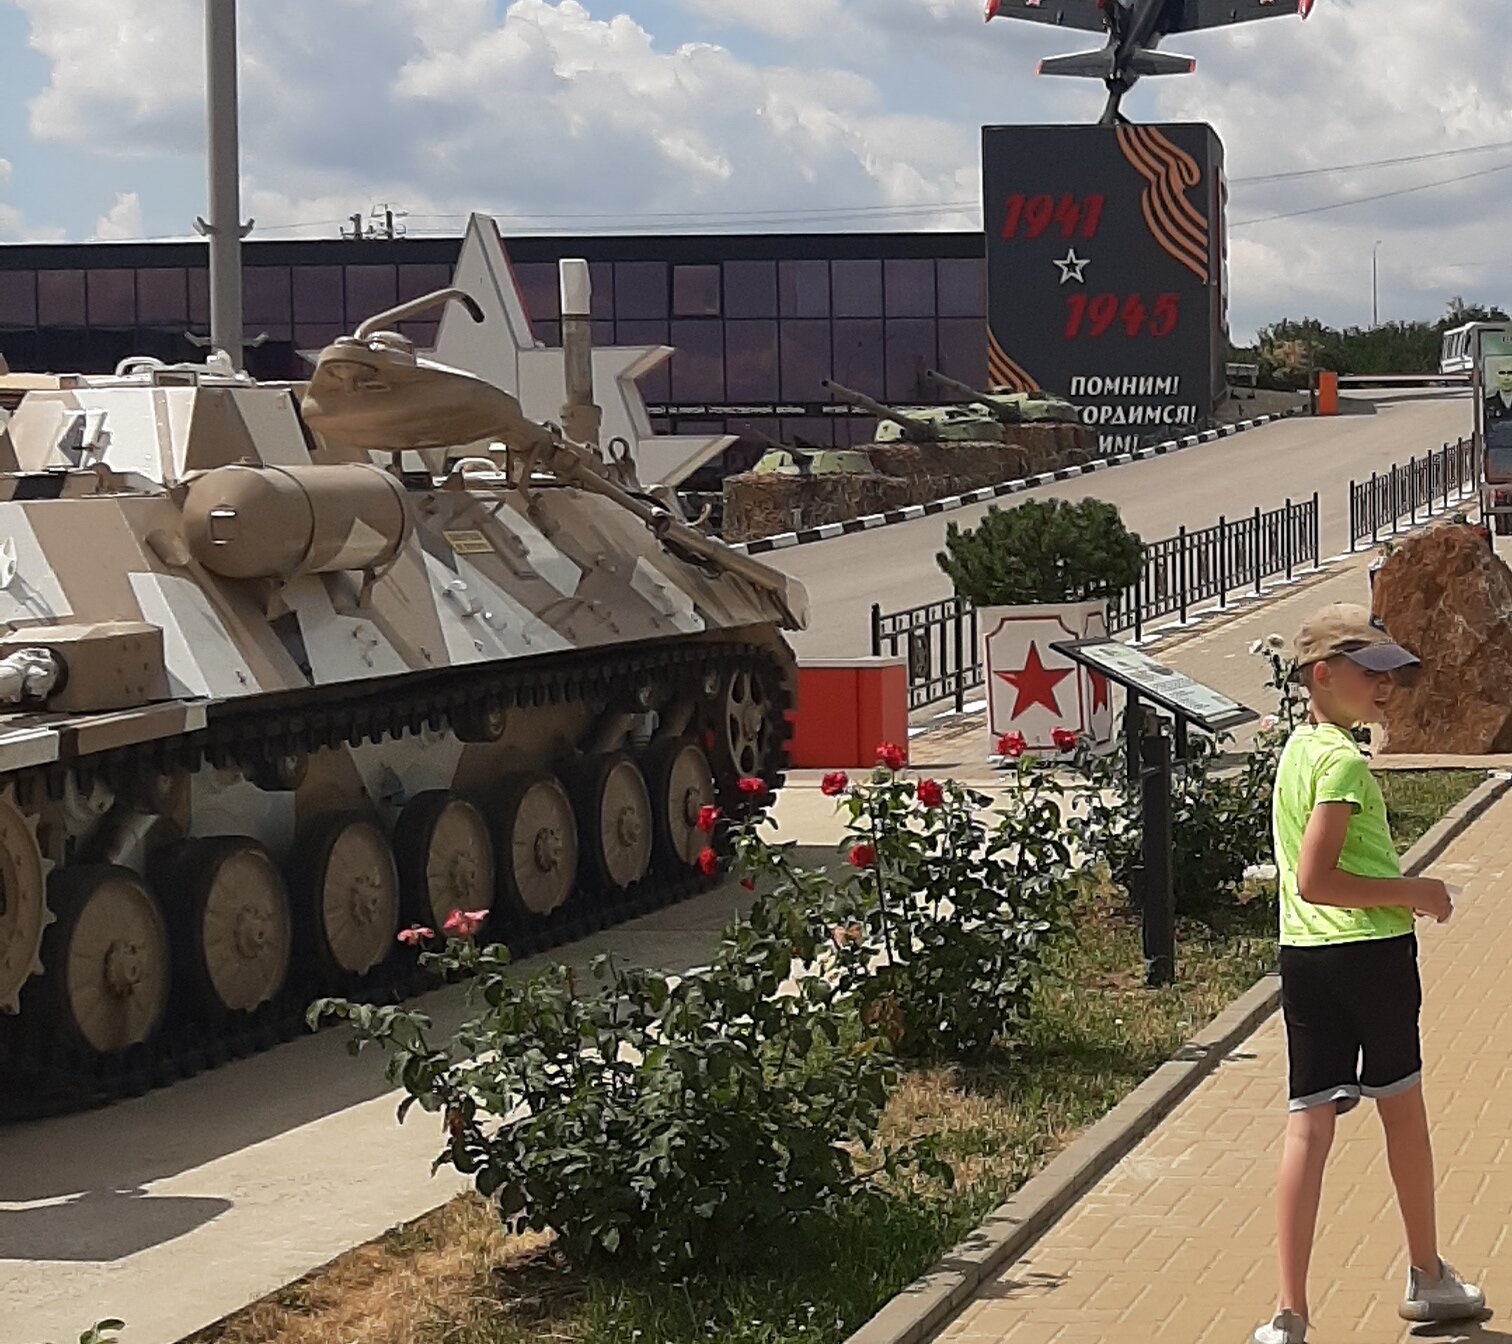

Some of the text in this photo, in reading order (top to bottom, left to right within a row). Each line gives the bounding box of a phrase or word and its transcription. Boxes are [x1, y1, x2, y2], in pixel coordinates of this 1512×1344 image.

[1002, 193, 1104, 240] 1941
[1064, 293, 1181, 338] 1945
[1070, 376, 1180, 396] ПОМНИМ!
[1099, 434, 1139, 454] ИМ!
